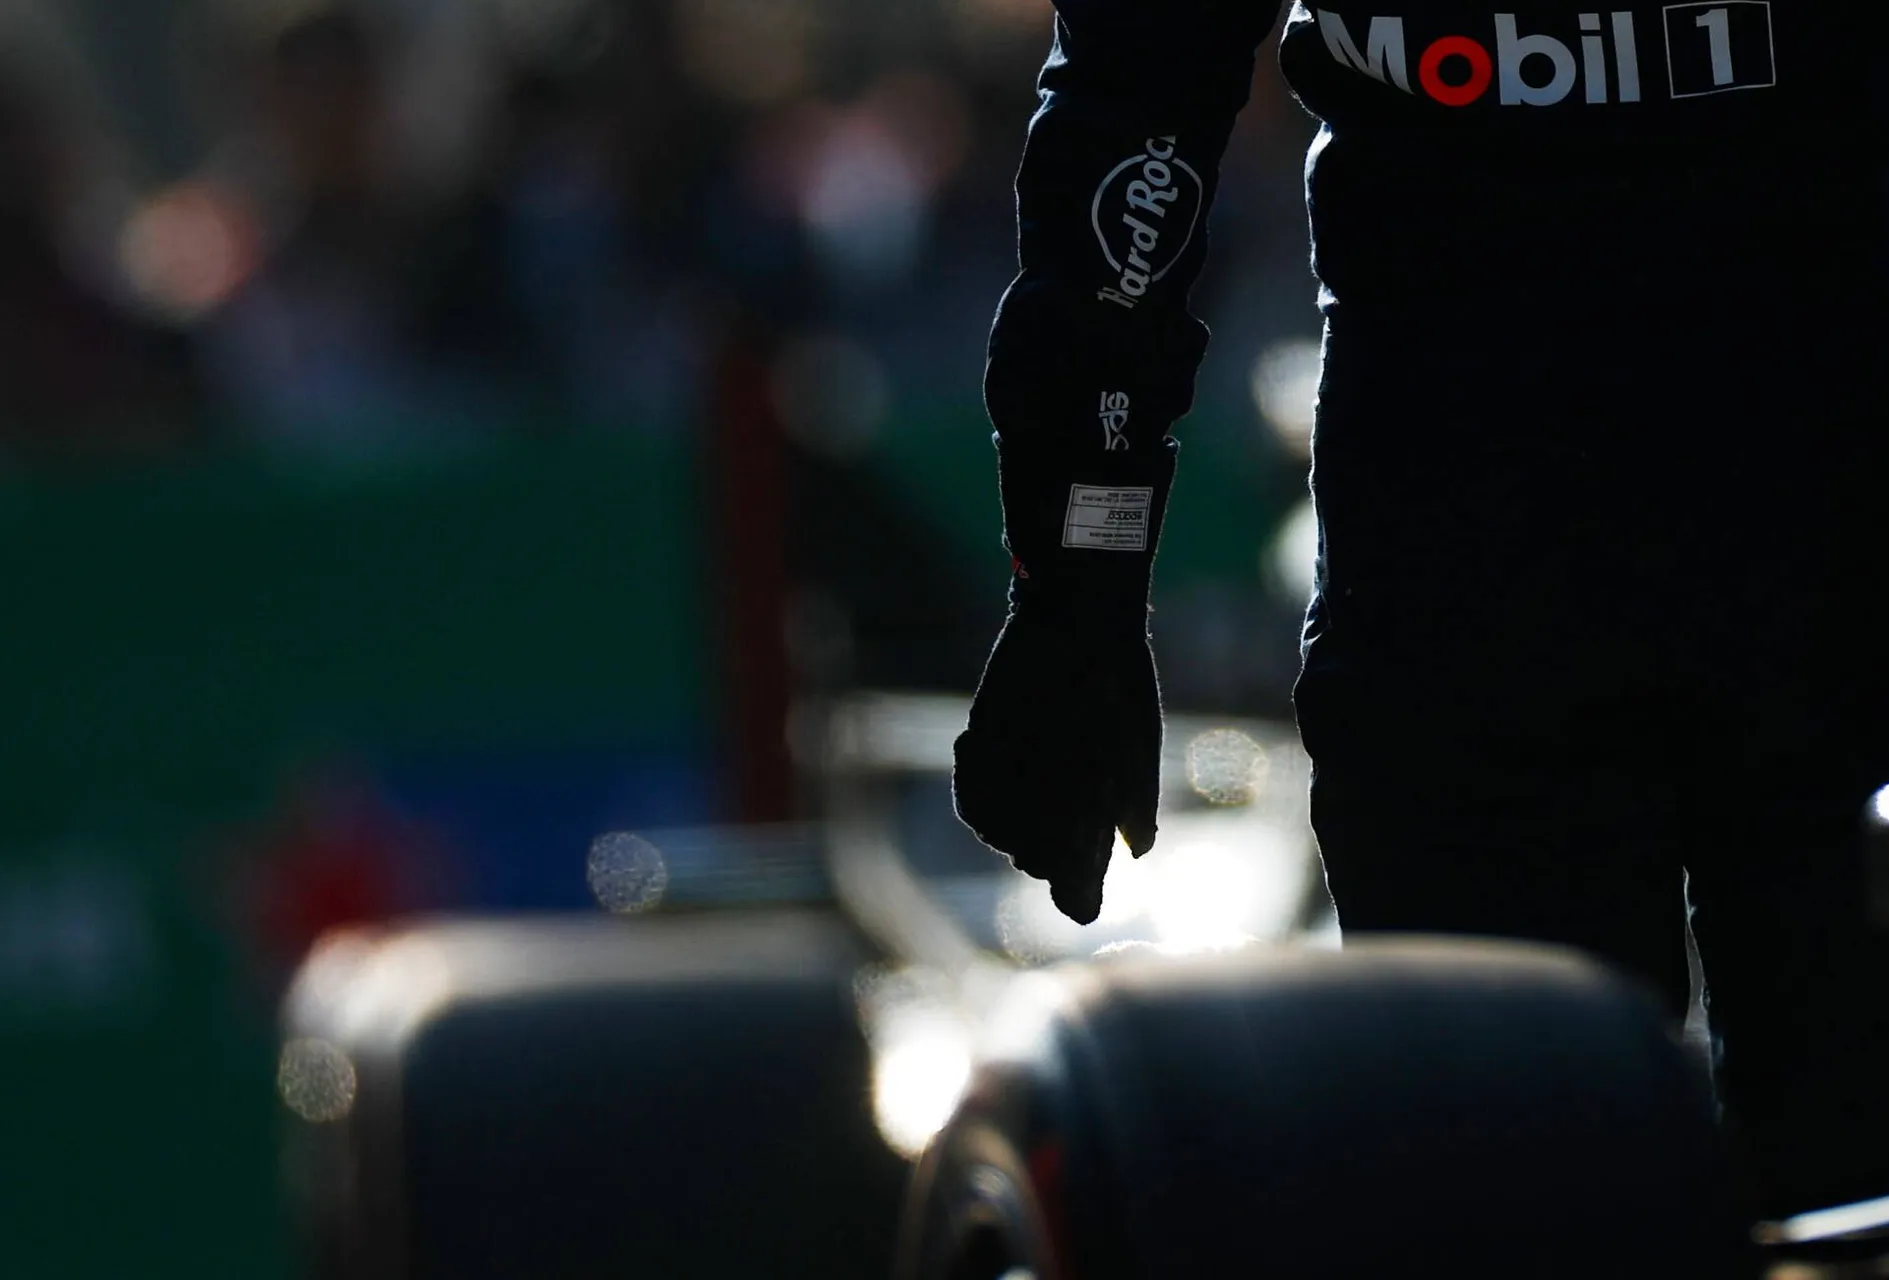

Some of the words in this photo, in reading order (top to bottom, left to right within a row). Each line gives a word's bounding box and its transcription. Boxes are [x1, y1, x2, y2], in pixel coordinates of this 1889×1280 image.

[1317, 8, 1641, 108] Mobil
[1695, 7, 1735, 86] 1
[1126, 135, 1179, 219] Roc
